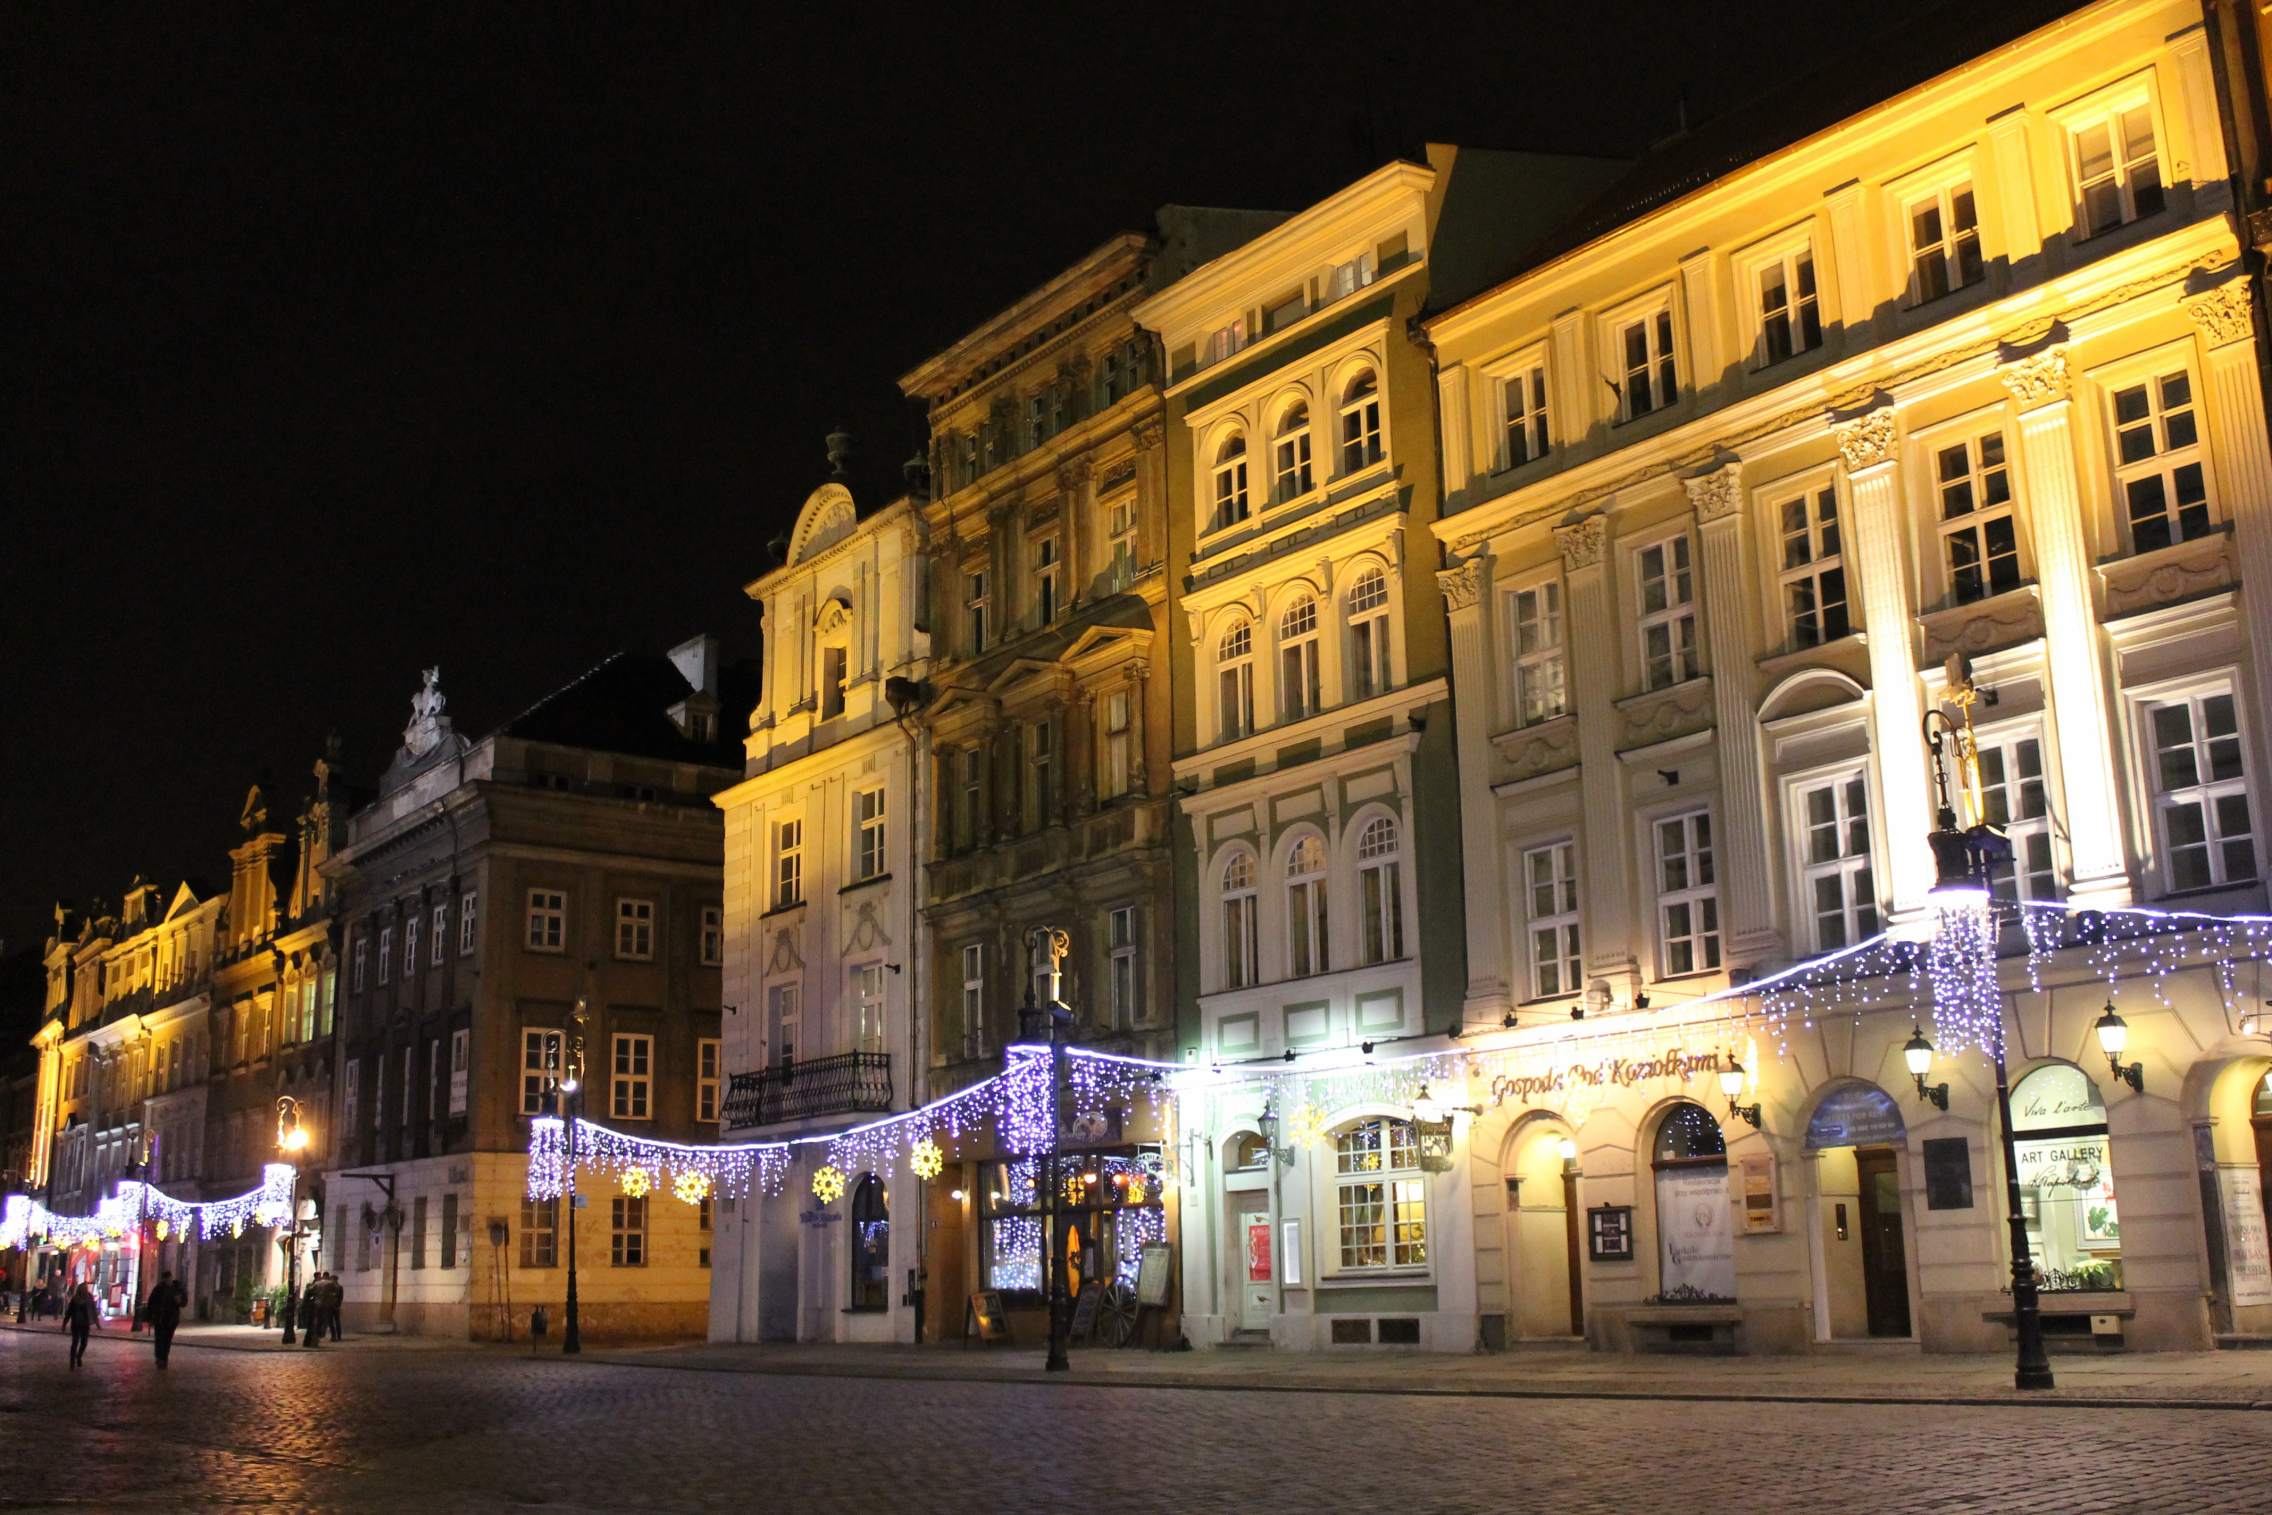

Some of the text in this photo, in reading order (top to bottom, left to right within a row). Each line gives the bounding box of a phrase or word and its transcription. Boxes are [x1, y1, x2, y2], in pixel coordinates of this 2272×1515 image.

[2024, 1097, 2047, 1117] Viva
[2021, 1146, 2103, 1164] ART GALLERY
